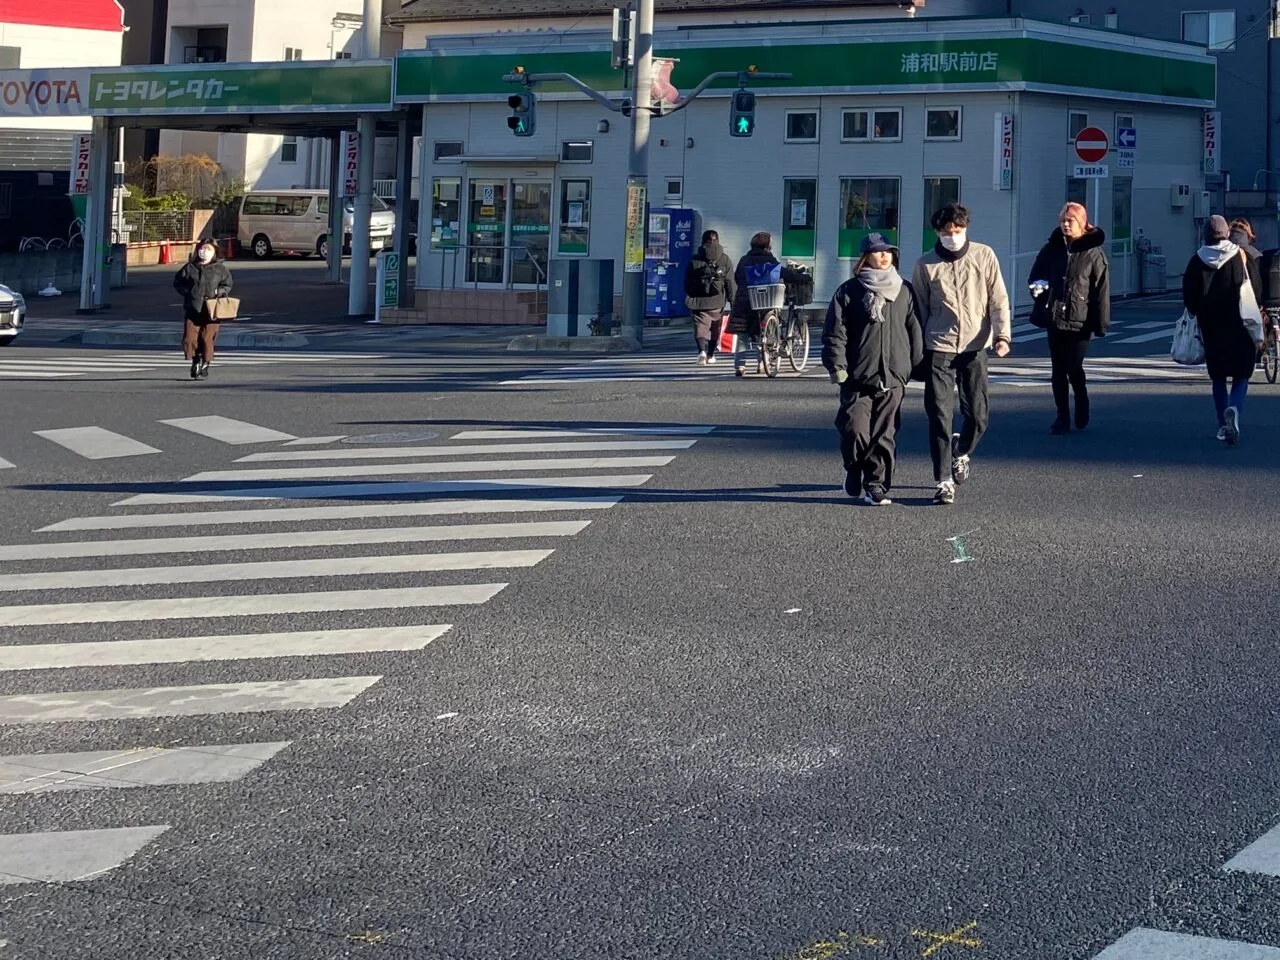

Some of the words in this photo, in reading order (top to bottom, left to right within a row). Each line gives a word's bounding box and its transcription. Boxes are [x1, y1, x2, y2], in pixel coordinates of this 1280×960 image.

[901, 51, 999, 73] 浦和駅前店
[0, 79, 81, 105] OYOTA
[95, 78, 239, 101] トヨタレンタカー
[1003, 115, 1012, 168] レンタカー
[1205, 114, 1215, 157] レンタカー
